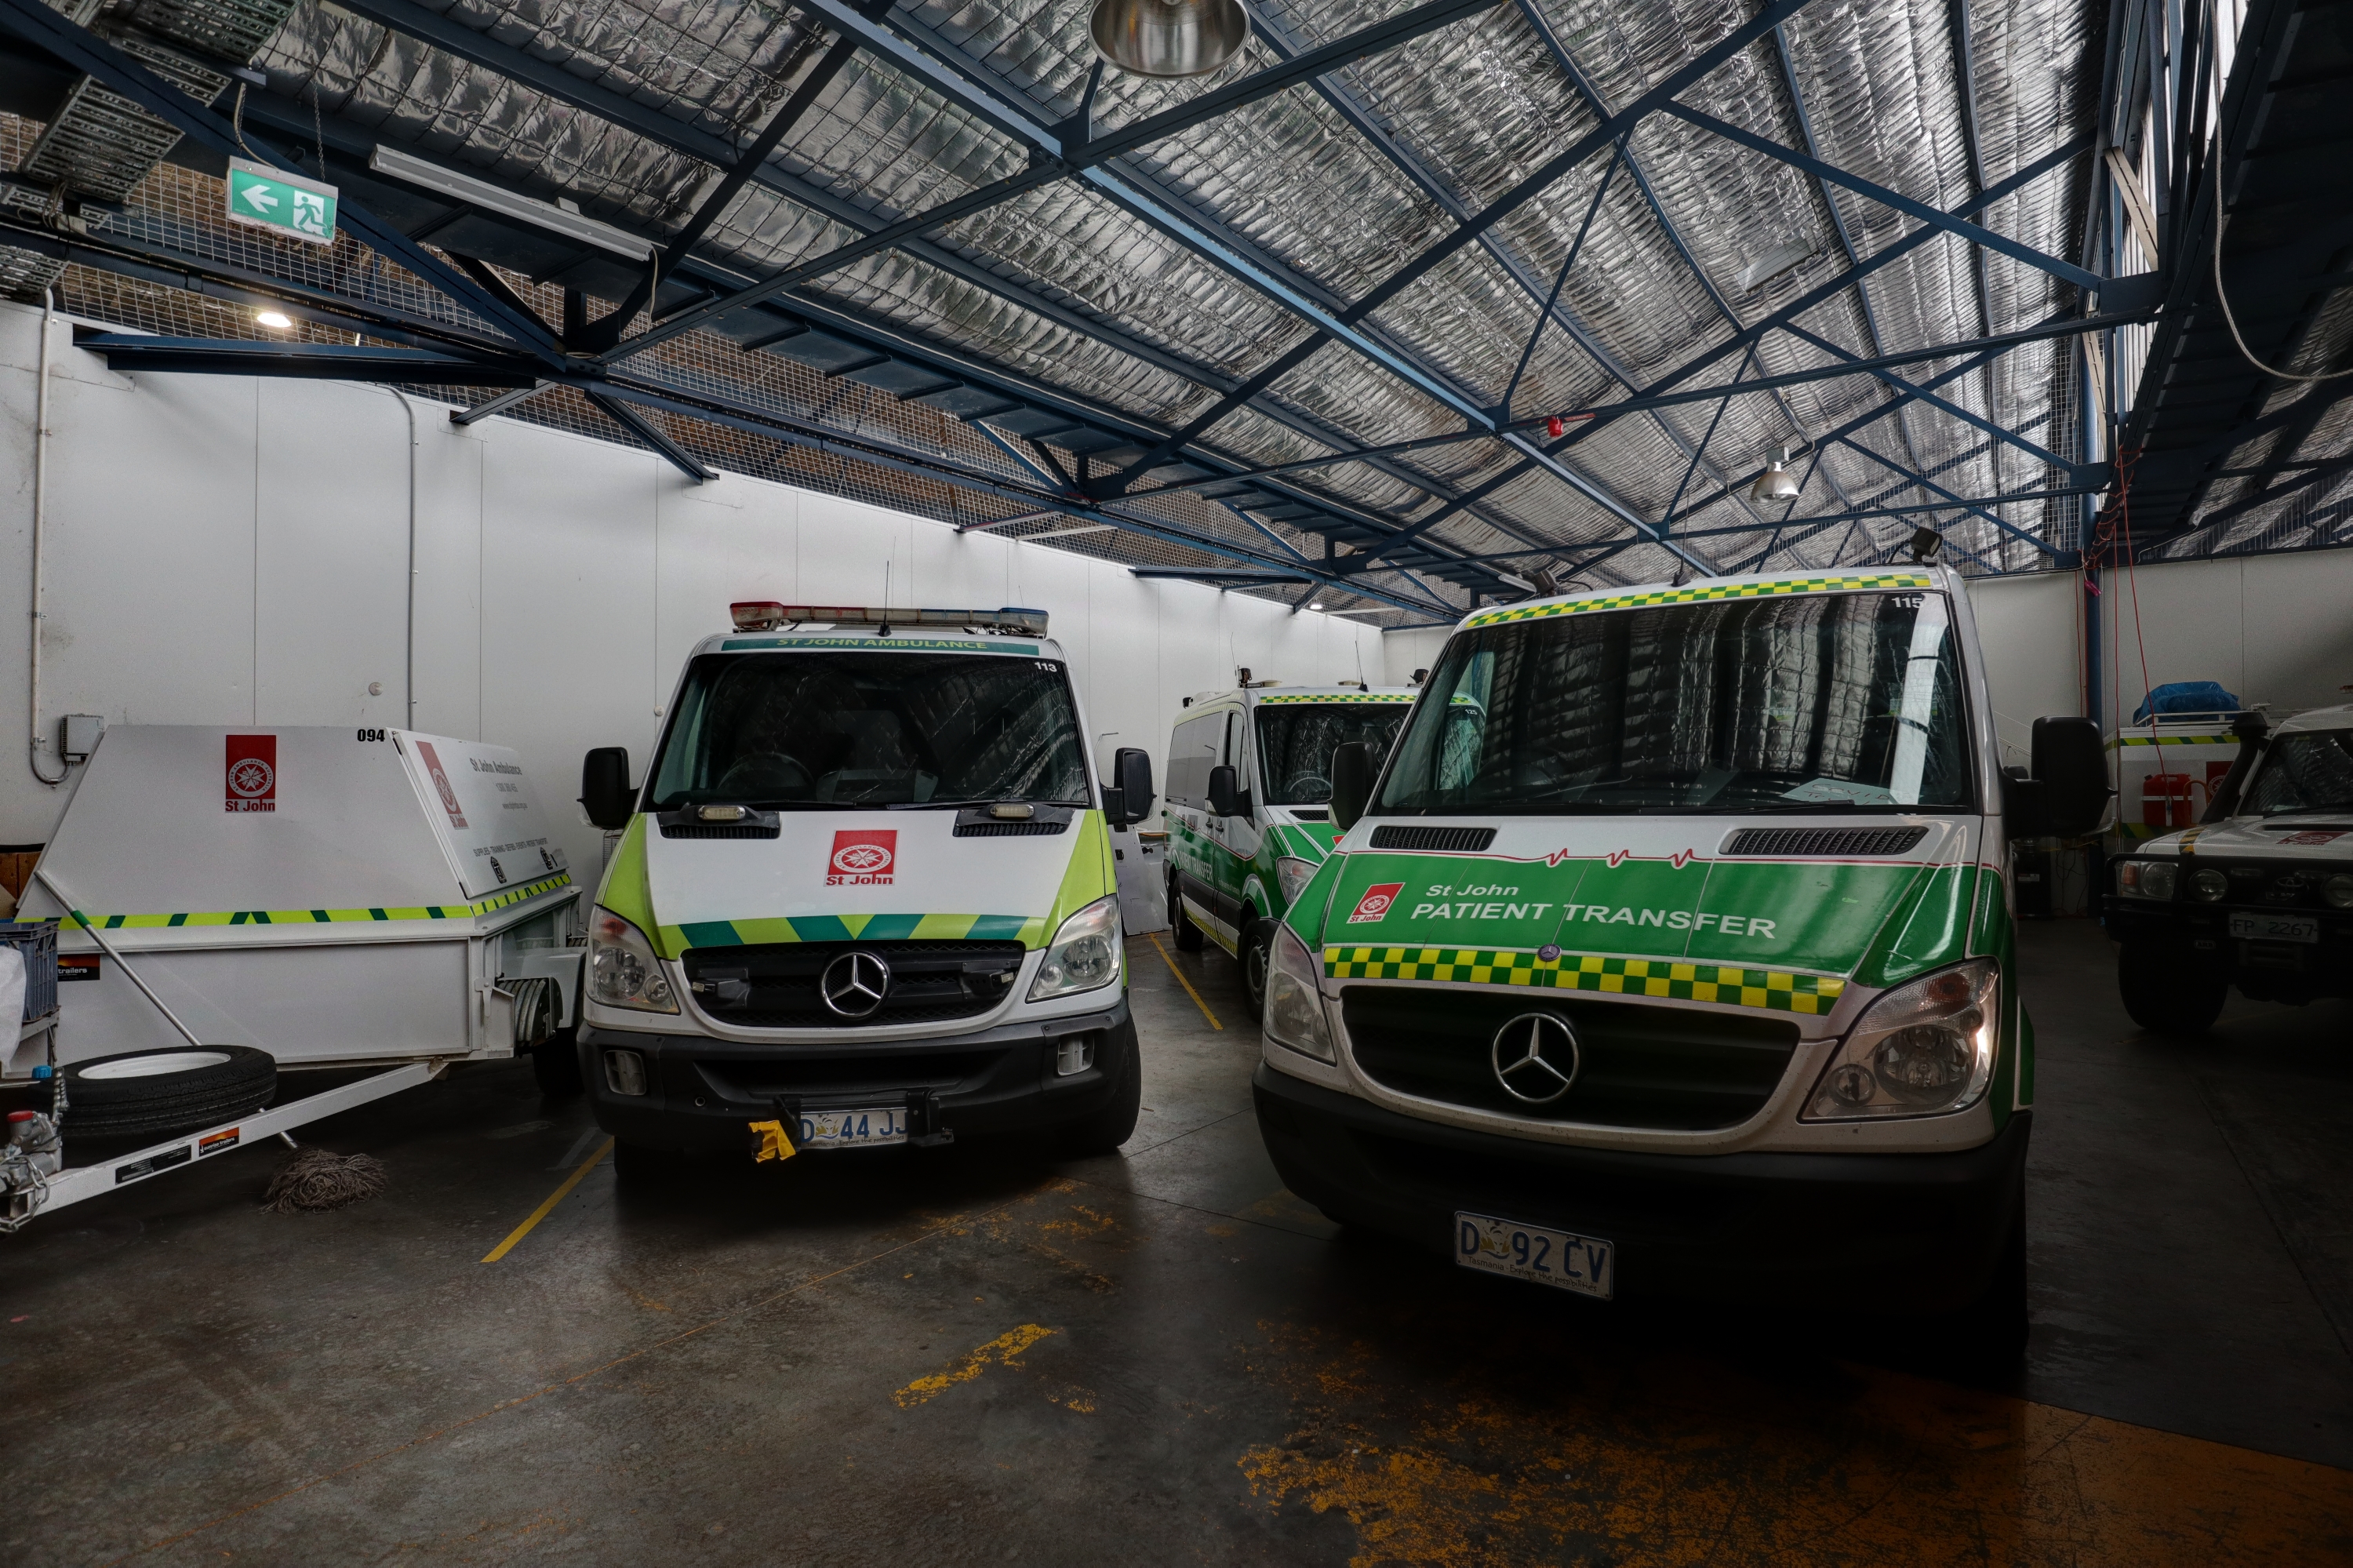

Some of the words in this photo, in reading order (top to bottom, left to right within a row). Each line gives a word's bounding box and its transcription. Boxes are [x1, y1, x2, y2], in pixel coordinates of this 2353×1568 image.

[1891, 597, 1923, 609] 115
[864, 639, 987, 649] AMBULANCE
[1035, 662, 1057, 672] 113
[357, 729, 385, 742] 094
[469, 758, 481, 773] St
[478, 759, 496, 773] John
[493, 761, 522, 776] Ambulance
[234, 759, 264, 769] AMBULANCE
[262, 766, 272, 791] AUSTRALIA
[225, 800, 239, 812] St
[242, 798, 275, 812] John
[473, 848, 489, 857] SUPPLIES
[489, 844, 504, 854] TRAINING
[1191, 857, 1213, 882] TRANSFER
[826, 876, 845, 886] St
[849, 874, 893, 885] John
[1426, 885, 1451, 897] St
[1457, 884, 1519, 896] John
[1410, 903, 1554, 919] PATIENT
[1562, 904, 1776, 939] TRANSFER
[2234, 919, 2255, 932] FP
[2268, 922, 2314, 937] 2267
[801, 1118, 814, 1143] D
[841, 1114, 870, 1139] 44
[879, 1111, 907, 1136] JJ
[204, 1142, 220, 1151] sunrise
[220, 1137, 235, 1145] trailers
[873, 1135, 905, 1144] possibilities
[1460, 1221, 1479, 1255] D
[1512, 1231, 1551, 1273] 92
[1564, 1240, 1606, 1282] CV
[1467, 1256, 1504, 1271] Tasmania
[1510, 1264, 1536, 1278] Explore
[1538, 1271, 1553, 1282] the
[1555, 1278, 1597, 1292] possibilities
